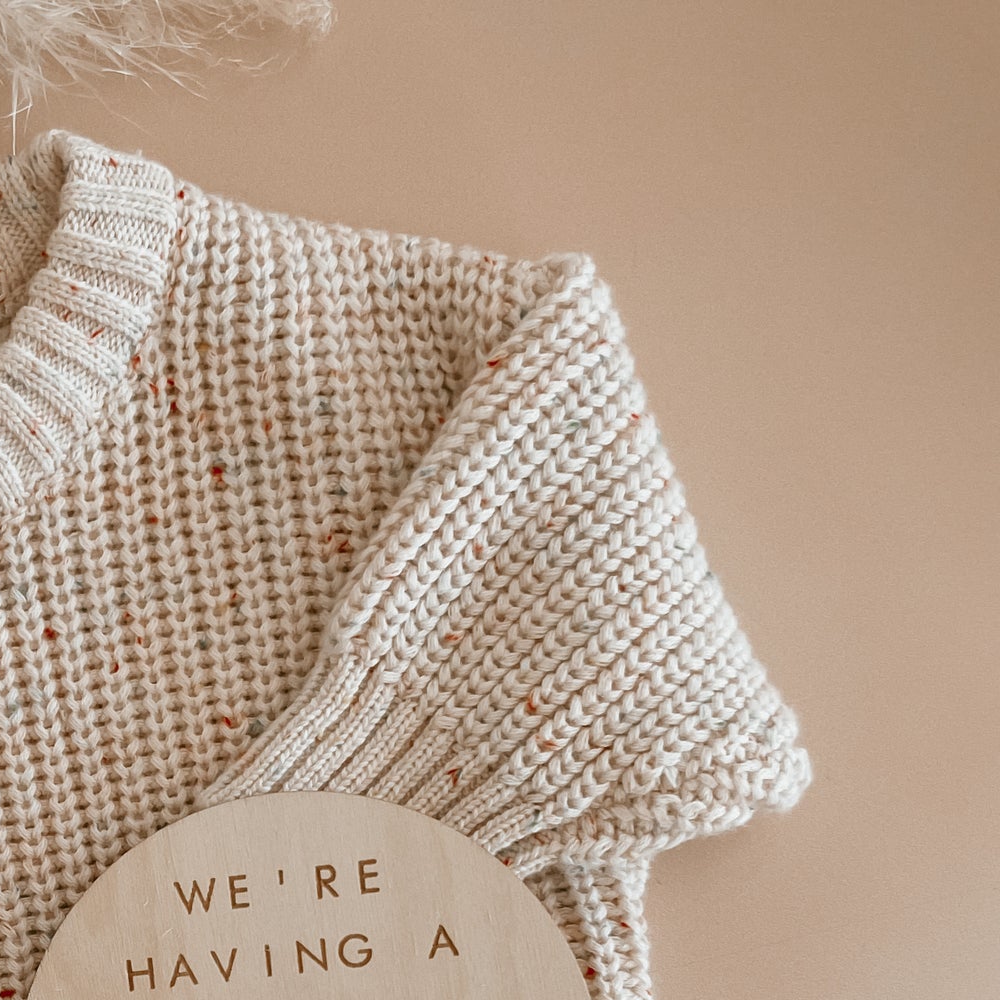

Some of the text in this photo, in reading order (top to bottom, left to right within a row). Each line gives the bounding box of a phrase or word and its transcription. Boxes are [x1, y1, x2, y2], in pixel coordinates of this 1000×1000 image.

[173, 858, 381, 914] WE'RE
[125, 924, 460, 992] HAVING A
